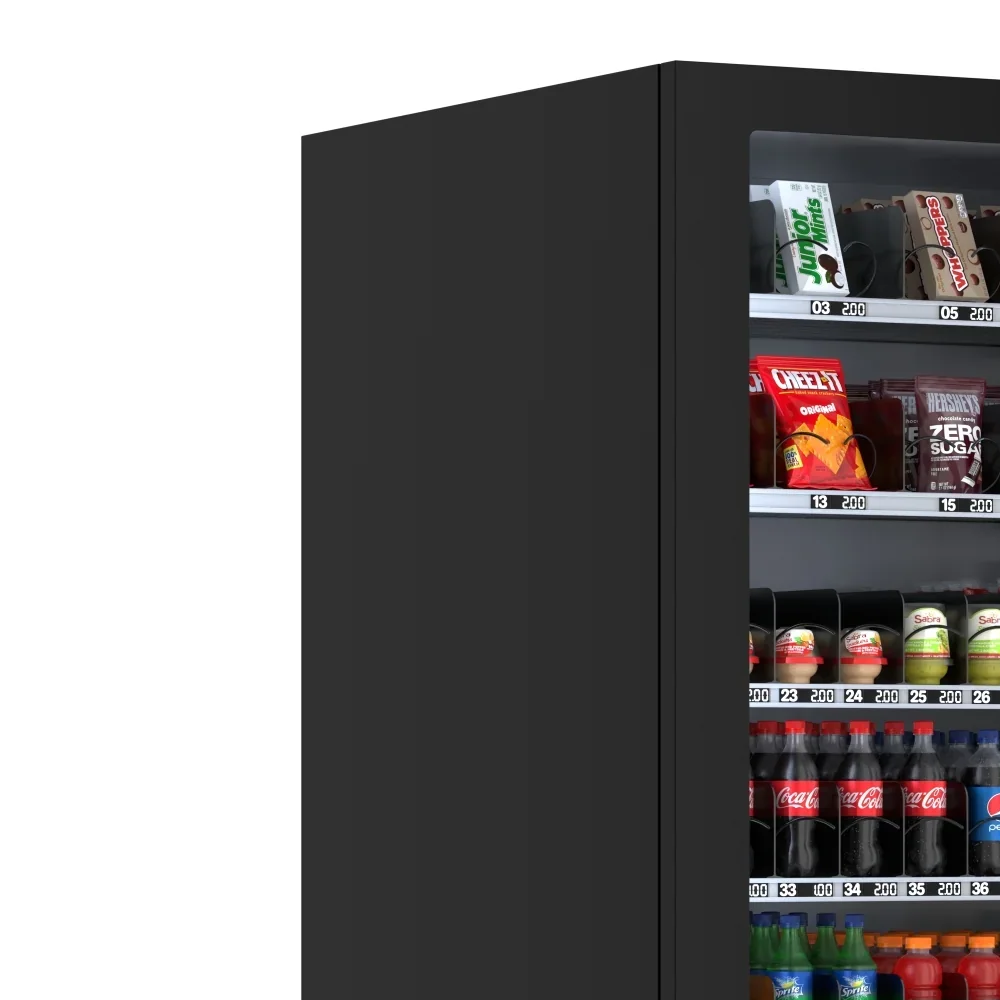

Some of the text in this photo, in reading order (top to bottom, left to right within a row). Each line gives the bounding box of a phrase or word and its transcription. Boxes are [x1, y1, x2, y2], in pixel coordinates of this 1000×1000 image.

[807, 197, 828, 244] Mints
[790, 208, 822, 285] Junior
[810, 300, 866, 316] 03 2.00
[940, 305, 992, 320] 05 2.00
[771, 368, 843, 392] CHEEZ-IT
[927, 392, 980, 415] HERSHEY'S
[929, 424, 981, 442] ZERO
[930, 441, 981, 455] SUGA
[812, 495, 865, 509] 13 2.00
[941, 498, 992, 512] 15 2.00
[914, 613, 941, 624] Sabra
[780, 688, 833, 702] 23 2.00
[845, 688, 898, 703] 24 2.00
[909, 689, 961, 703] 25 2.00
[973, 690, 990, 703] 26
[779, 883, 832, 896] 33 1.00
[843, 882, 896, 896] 34 2.00
[908, 882, 960, 895] 35 2.00
[971, 881, 989, 895] 36
[775, 986, 800, 998] Sprite
[842, 986, 868, 998] Sprite
